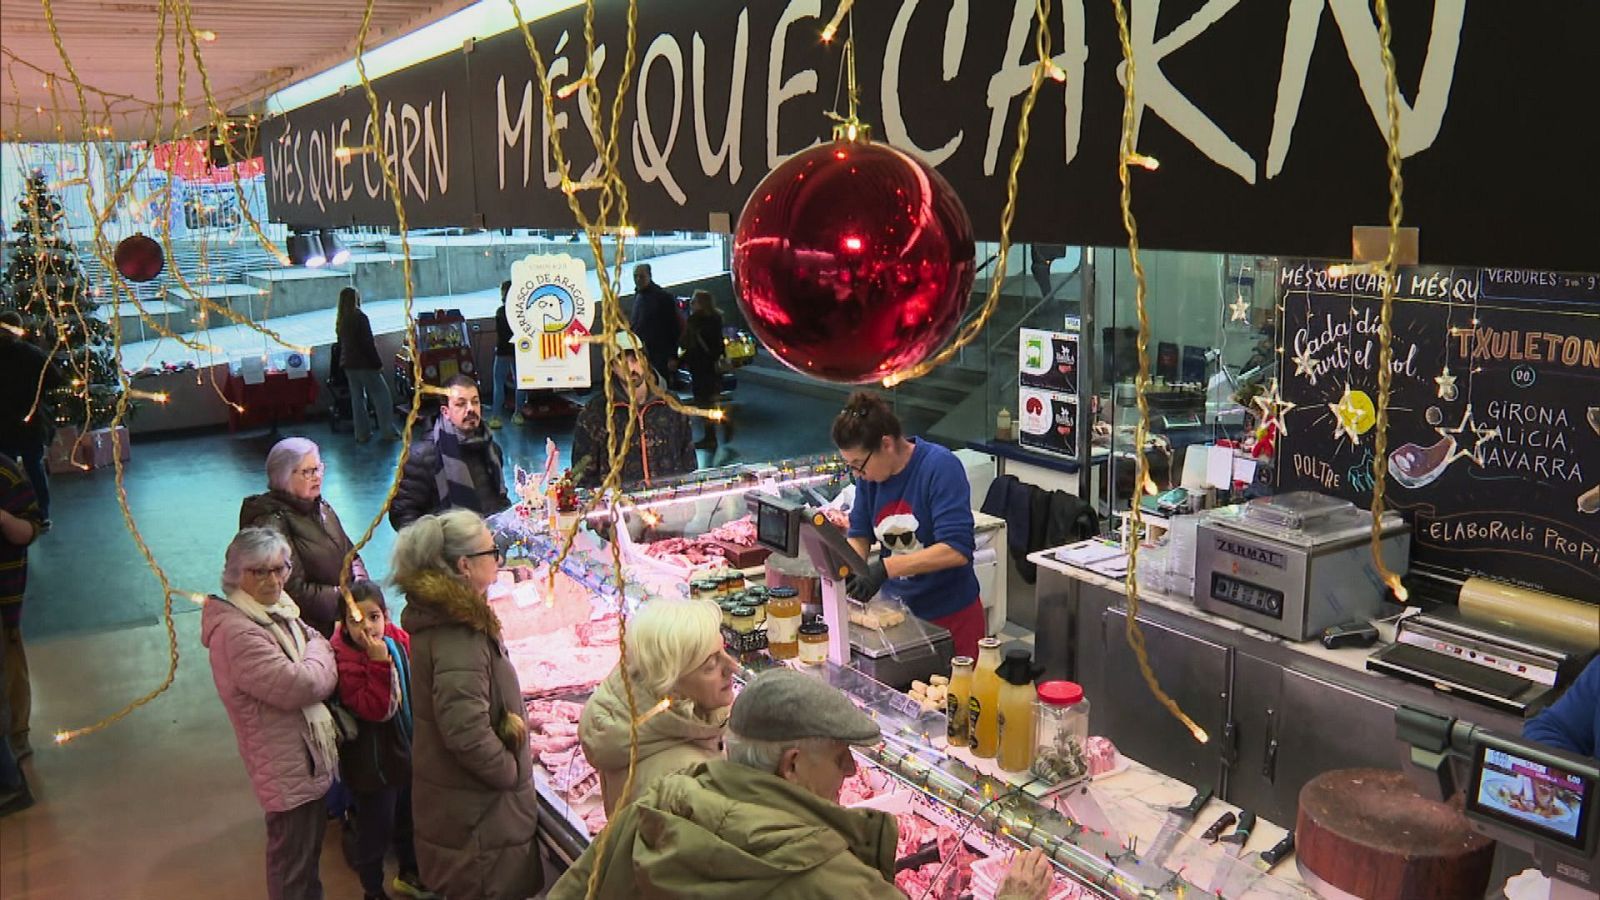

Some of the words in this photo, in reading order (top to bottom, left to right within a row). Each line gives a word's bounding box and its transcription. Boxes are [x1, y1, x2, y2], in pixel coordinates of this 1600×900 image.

[497, 30, 606, 190] MÉS
[632, 0, 822, 206] QUE
[881, 0, 1466, 185] CARN
[270, 122, 305, 206] MÉS
[309, 118, 354, 213] QUE
[363, 90, 448, 204] CARN
[536, 273, 551, 285] DE
[1281, 264, 1313, 287] MÉS
[1315, 270, 1350, 291] QUE
[1410, 272, 1450, 298] MÉS
[1354, 340, 1373, 370] el
[1293, 453, 1341, 489] POLTRE
[1473, 446, 1583, 484] NAVARRA
[1216, 539, 1279, 564] ZERMAT
